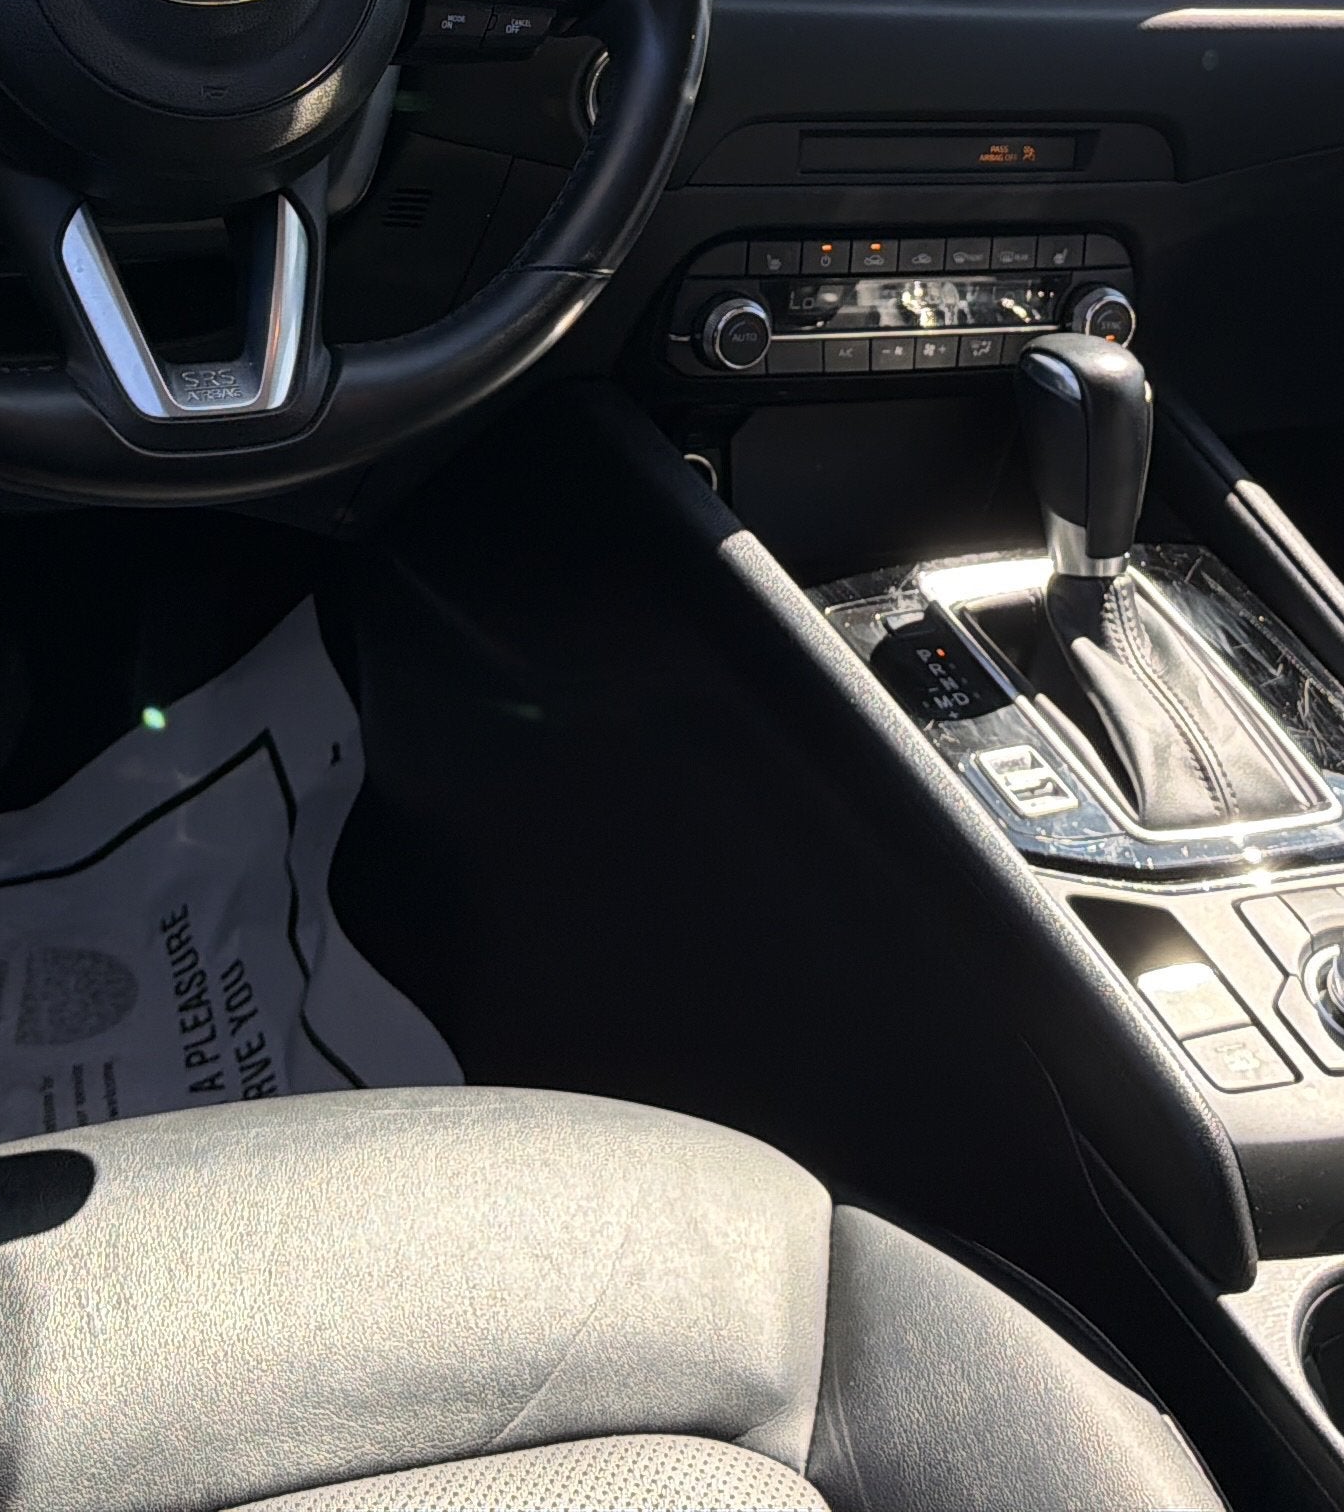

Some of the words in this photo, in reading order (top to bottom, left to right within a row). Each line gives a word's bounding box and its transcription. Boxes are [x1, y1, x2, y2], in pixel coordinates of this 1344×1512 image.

[441, 19, 453, 30] ON
[506, 24, 520, 34] OFF
[731, 332, 757, 342] AUTO
[916, 649, 932, 664] P
[928, 663, 948, 677] R
[939, 676, 959, 691] N
[161, 903, 220, 1069] PLEASURE
[221, 959, 258, 1036] YOU
[189, 1072, 225, 1093] A
